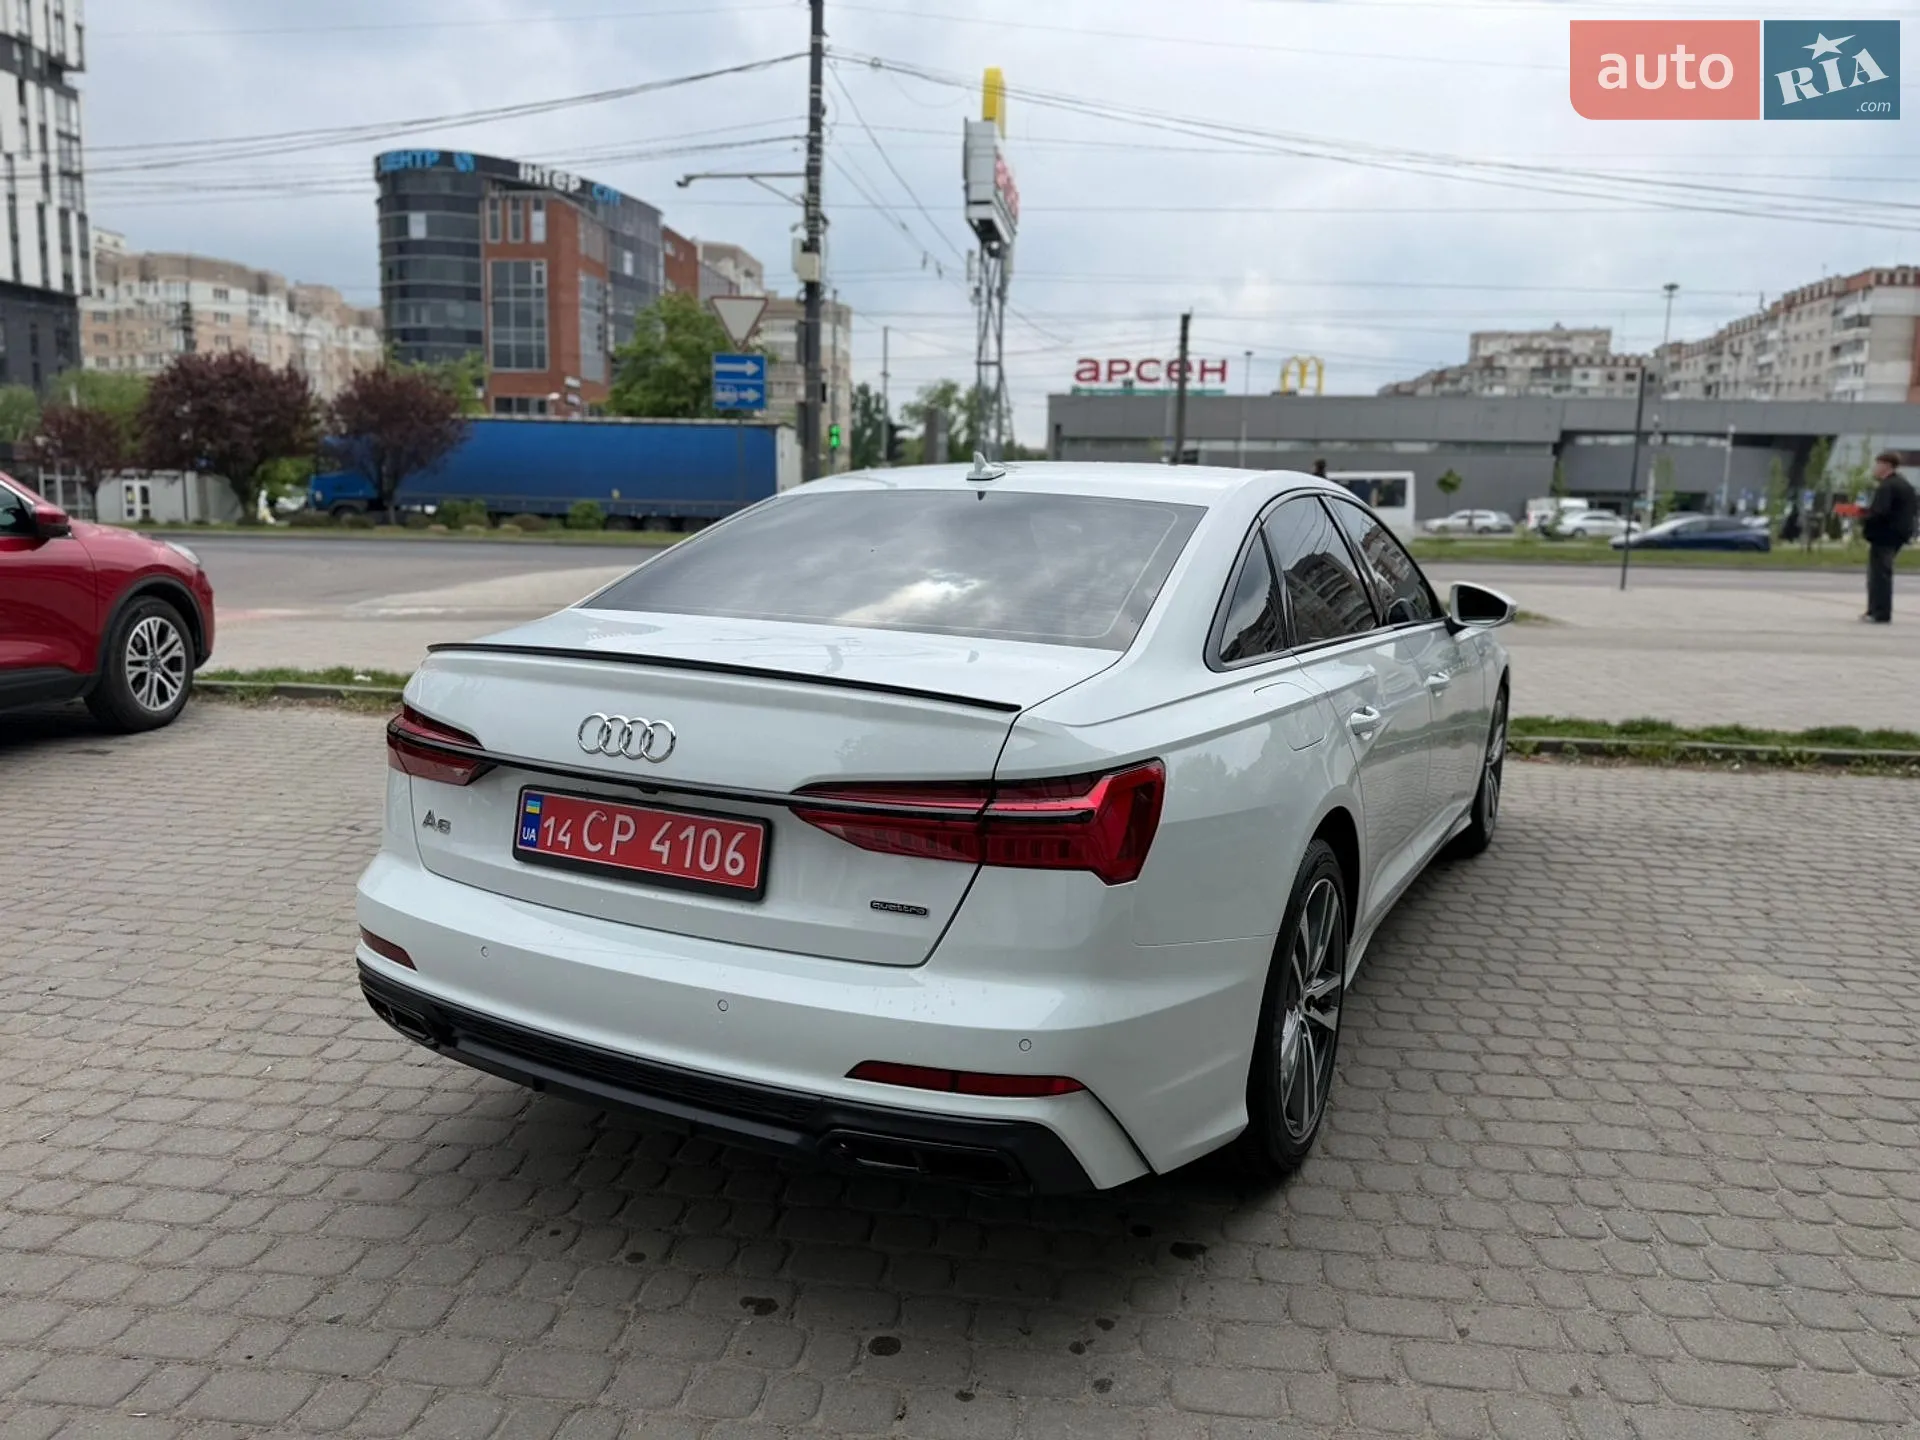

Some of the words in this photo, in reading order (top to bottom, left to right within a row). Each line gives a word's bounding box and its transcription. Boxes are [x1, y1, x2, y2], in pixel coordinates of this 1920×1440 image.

[422, 809, 452, 835] A6
[523, 827, 536, 841] UA
[543, 815, 573, 850] 14
[650, 821, 747, 877] 4106
[871, 901, 926, 915] quattro
